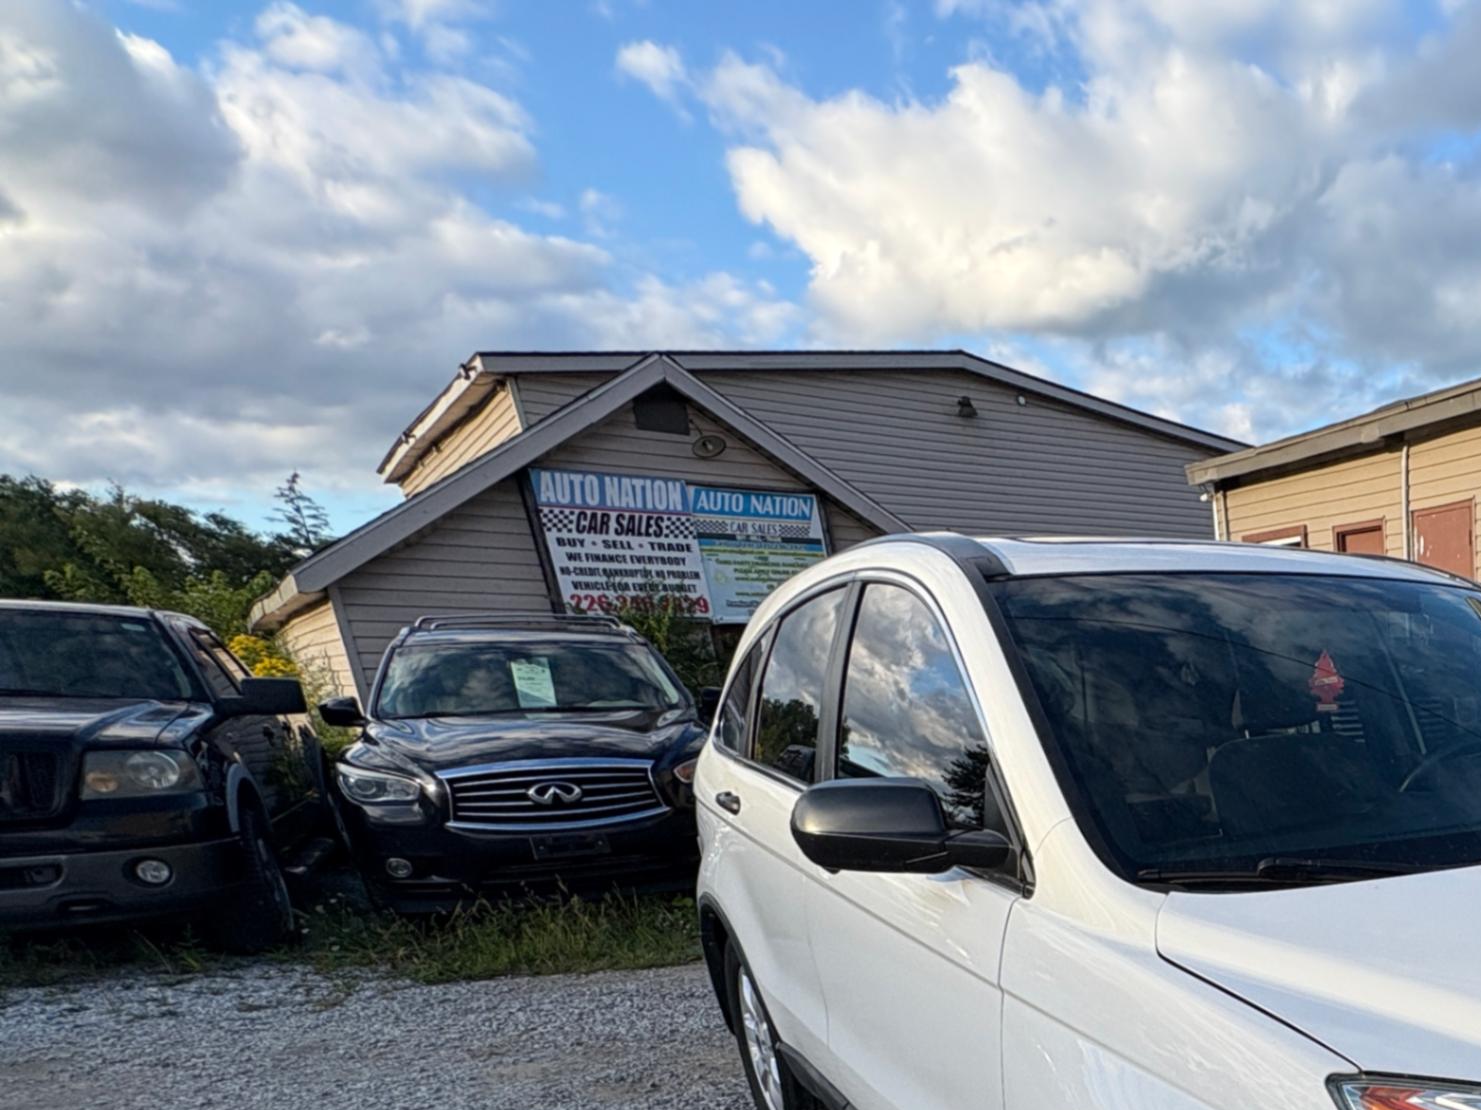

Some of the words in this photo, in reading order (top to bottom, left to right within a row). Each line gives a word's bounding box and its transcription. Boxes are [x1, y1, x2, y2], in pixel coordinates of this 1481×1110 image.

[539, 470, 600, 506] AUTO
[604, 476, 684, 512] NATION
[696, 490, 744, 513] AUTO
[749, 494, 811, 518] NATION
[575, 510, 611, 536] CAR
[614, 513, 666, 538] SALES
[729, 521, 748, 534] CAR
[751, 522, 781, 535] SALES
[555, 537, 585, 548] BUY
[602, 539, 635, 551] SELL
[648, 541, 693, 553] TRADE
[566, 551, 584, 563] WE
[585, 552, 628, 565] FINANCE
[630, 554, 687, 567] EVERYBODY
